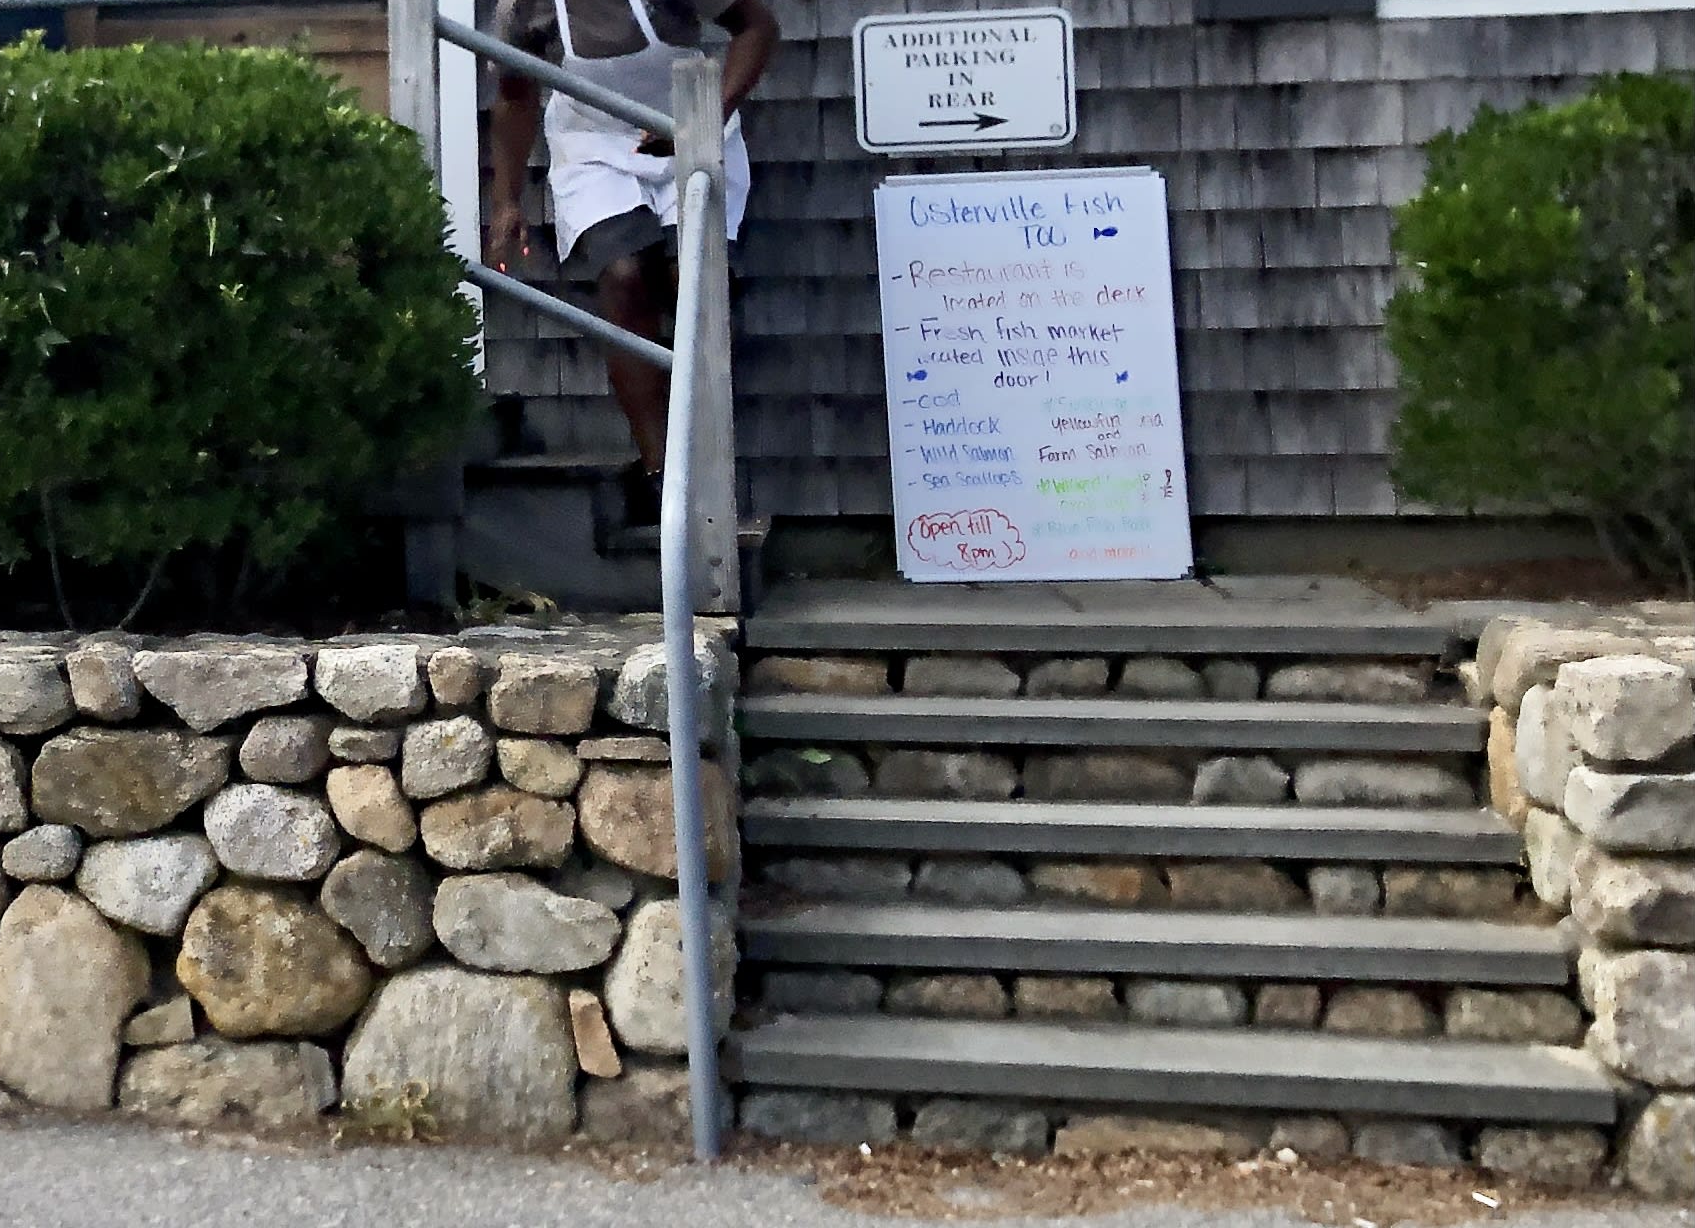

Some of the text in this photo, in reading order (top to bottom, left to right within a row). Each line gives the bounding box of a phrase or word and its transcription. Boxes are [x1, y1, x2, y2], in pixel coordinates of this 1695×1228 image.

[884, 28, 1037, 48] ADDITIONAL
[905, 48, 1015, 68] PARKING
[949, 72, 973, 86] IN
[929, 92, 996, 108] REAR
[996, 316, 1037, 341] fish
[1048, 324, 1125, 343] market
[1039, 445, 1077, 463] Farm
